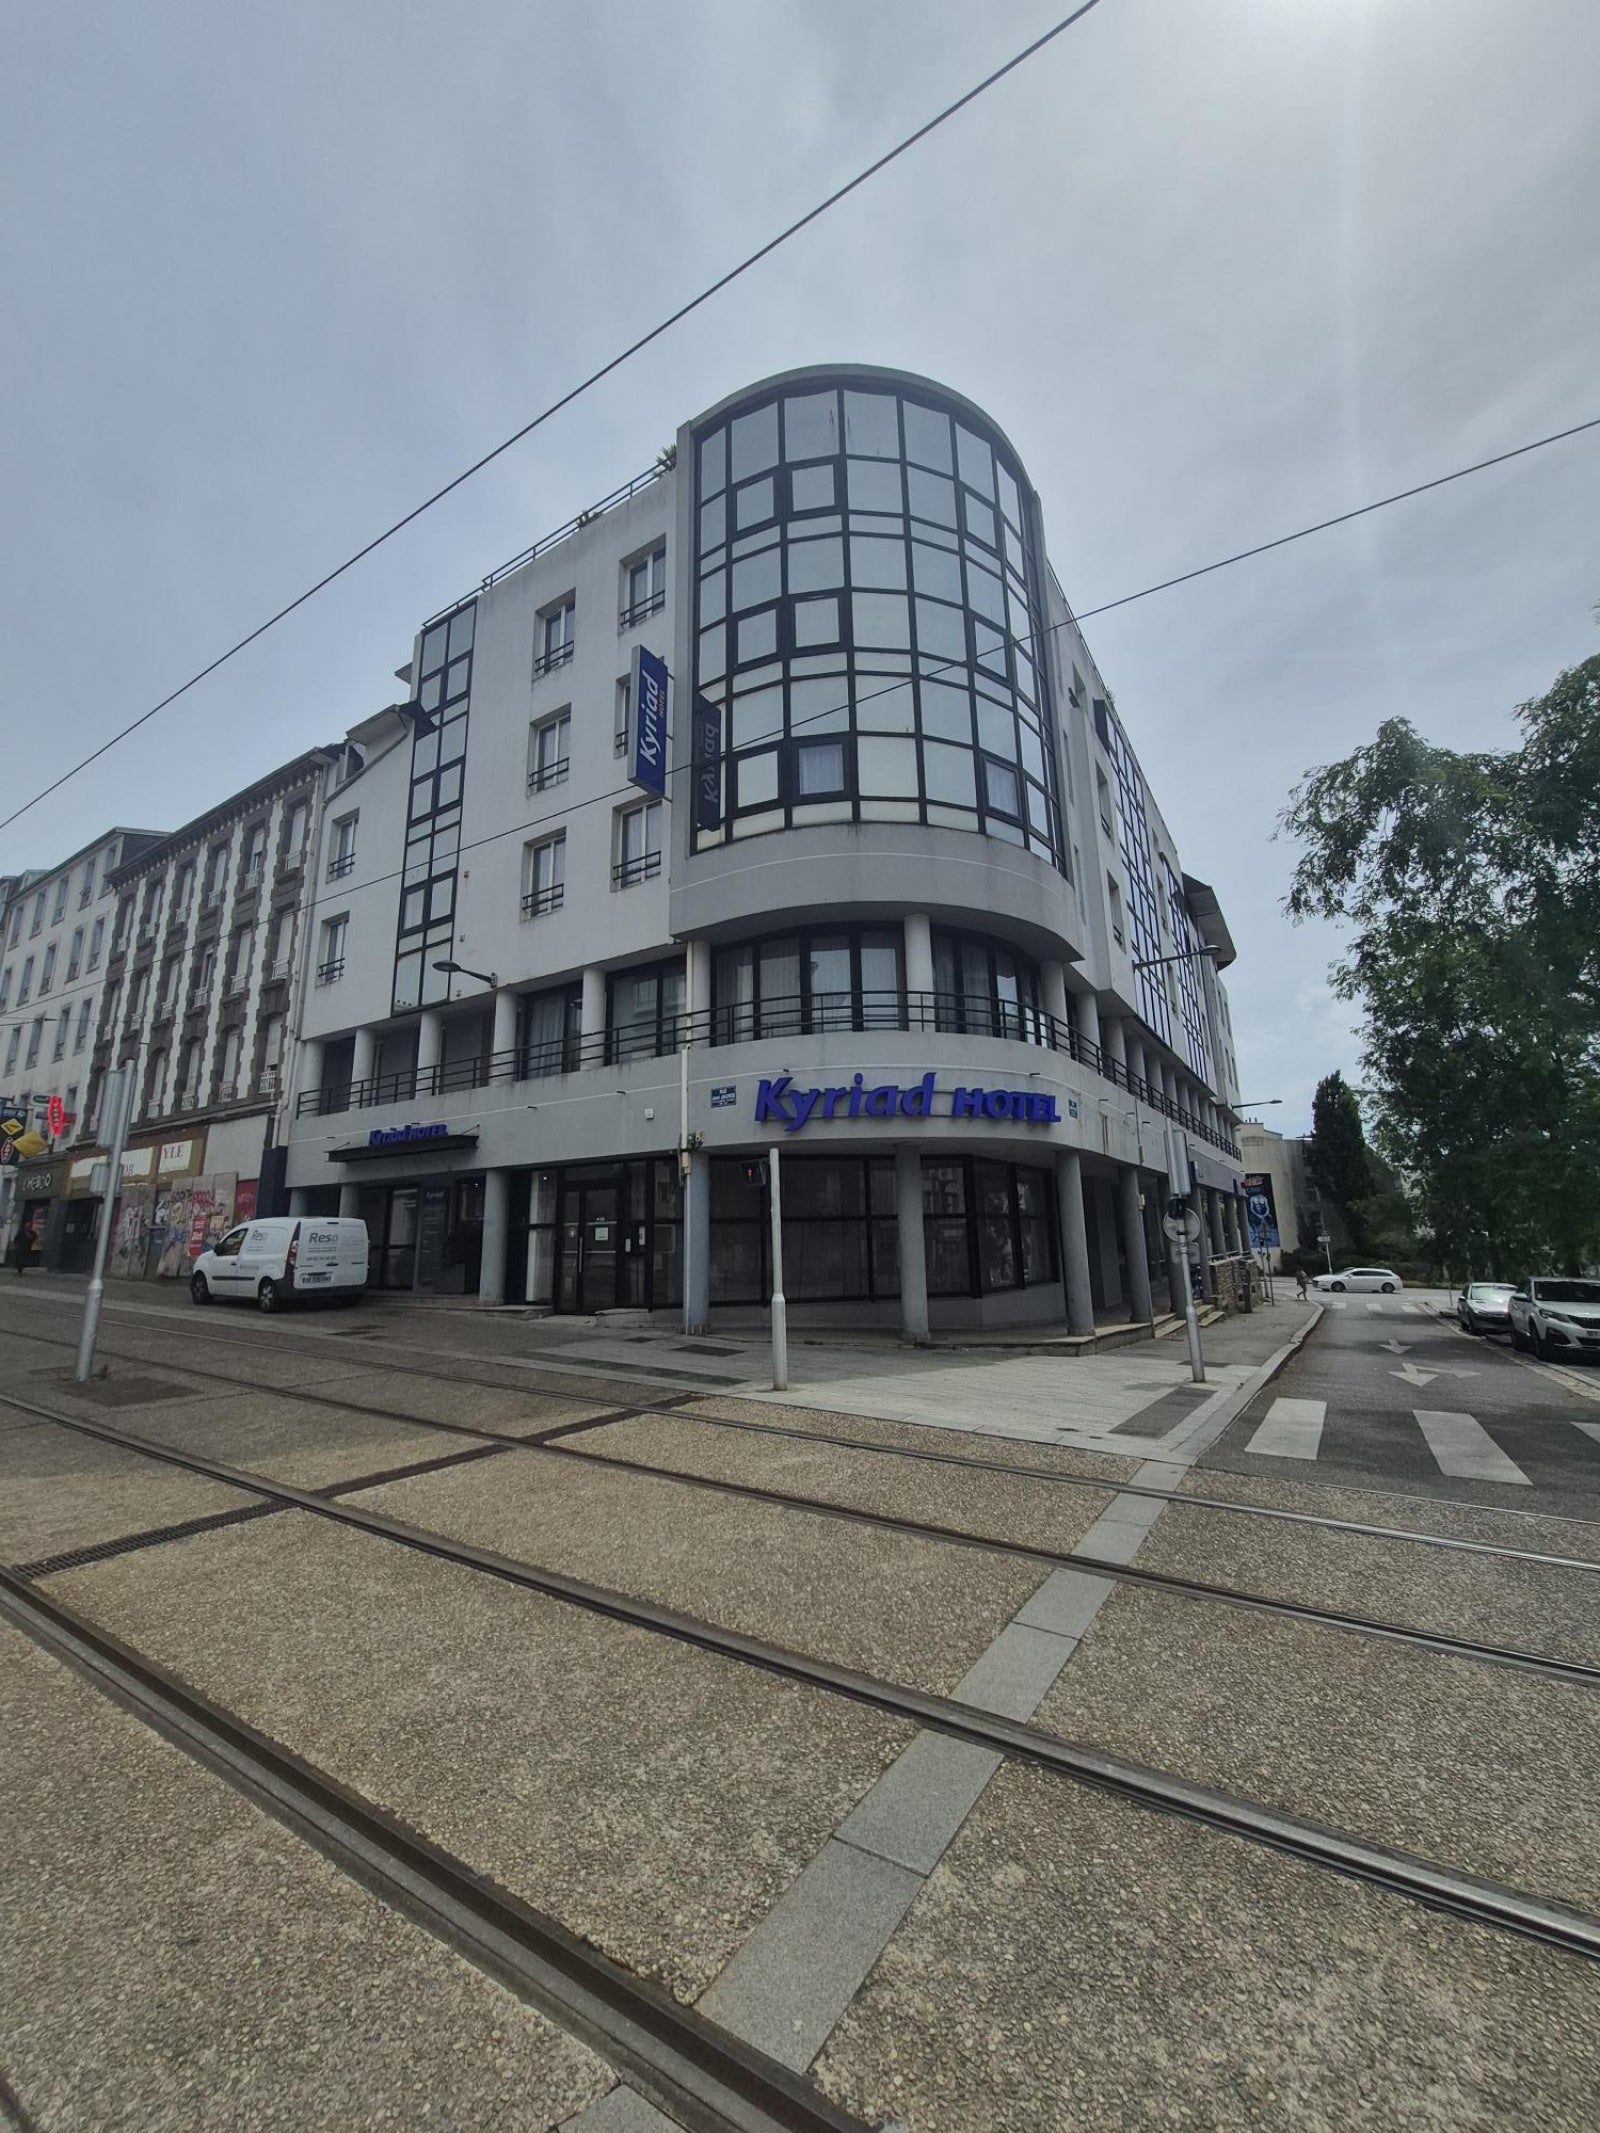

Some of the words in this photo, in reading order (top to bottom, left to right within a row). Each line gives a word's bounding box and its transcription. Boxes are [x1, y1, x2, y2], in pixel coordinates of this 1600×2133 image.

[640, 669, 661, 767] Kyriad
[754, 1071, 937, 1132] Kyriad
[952, 1087, 1062, 1122] HOTEL
